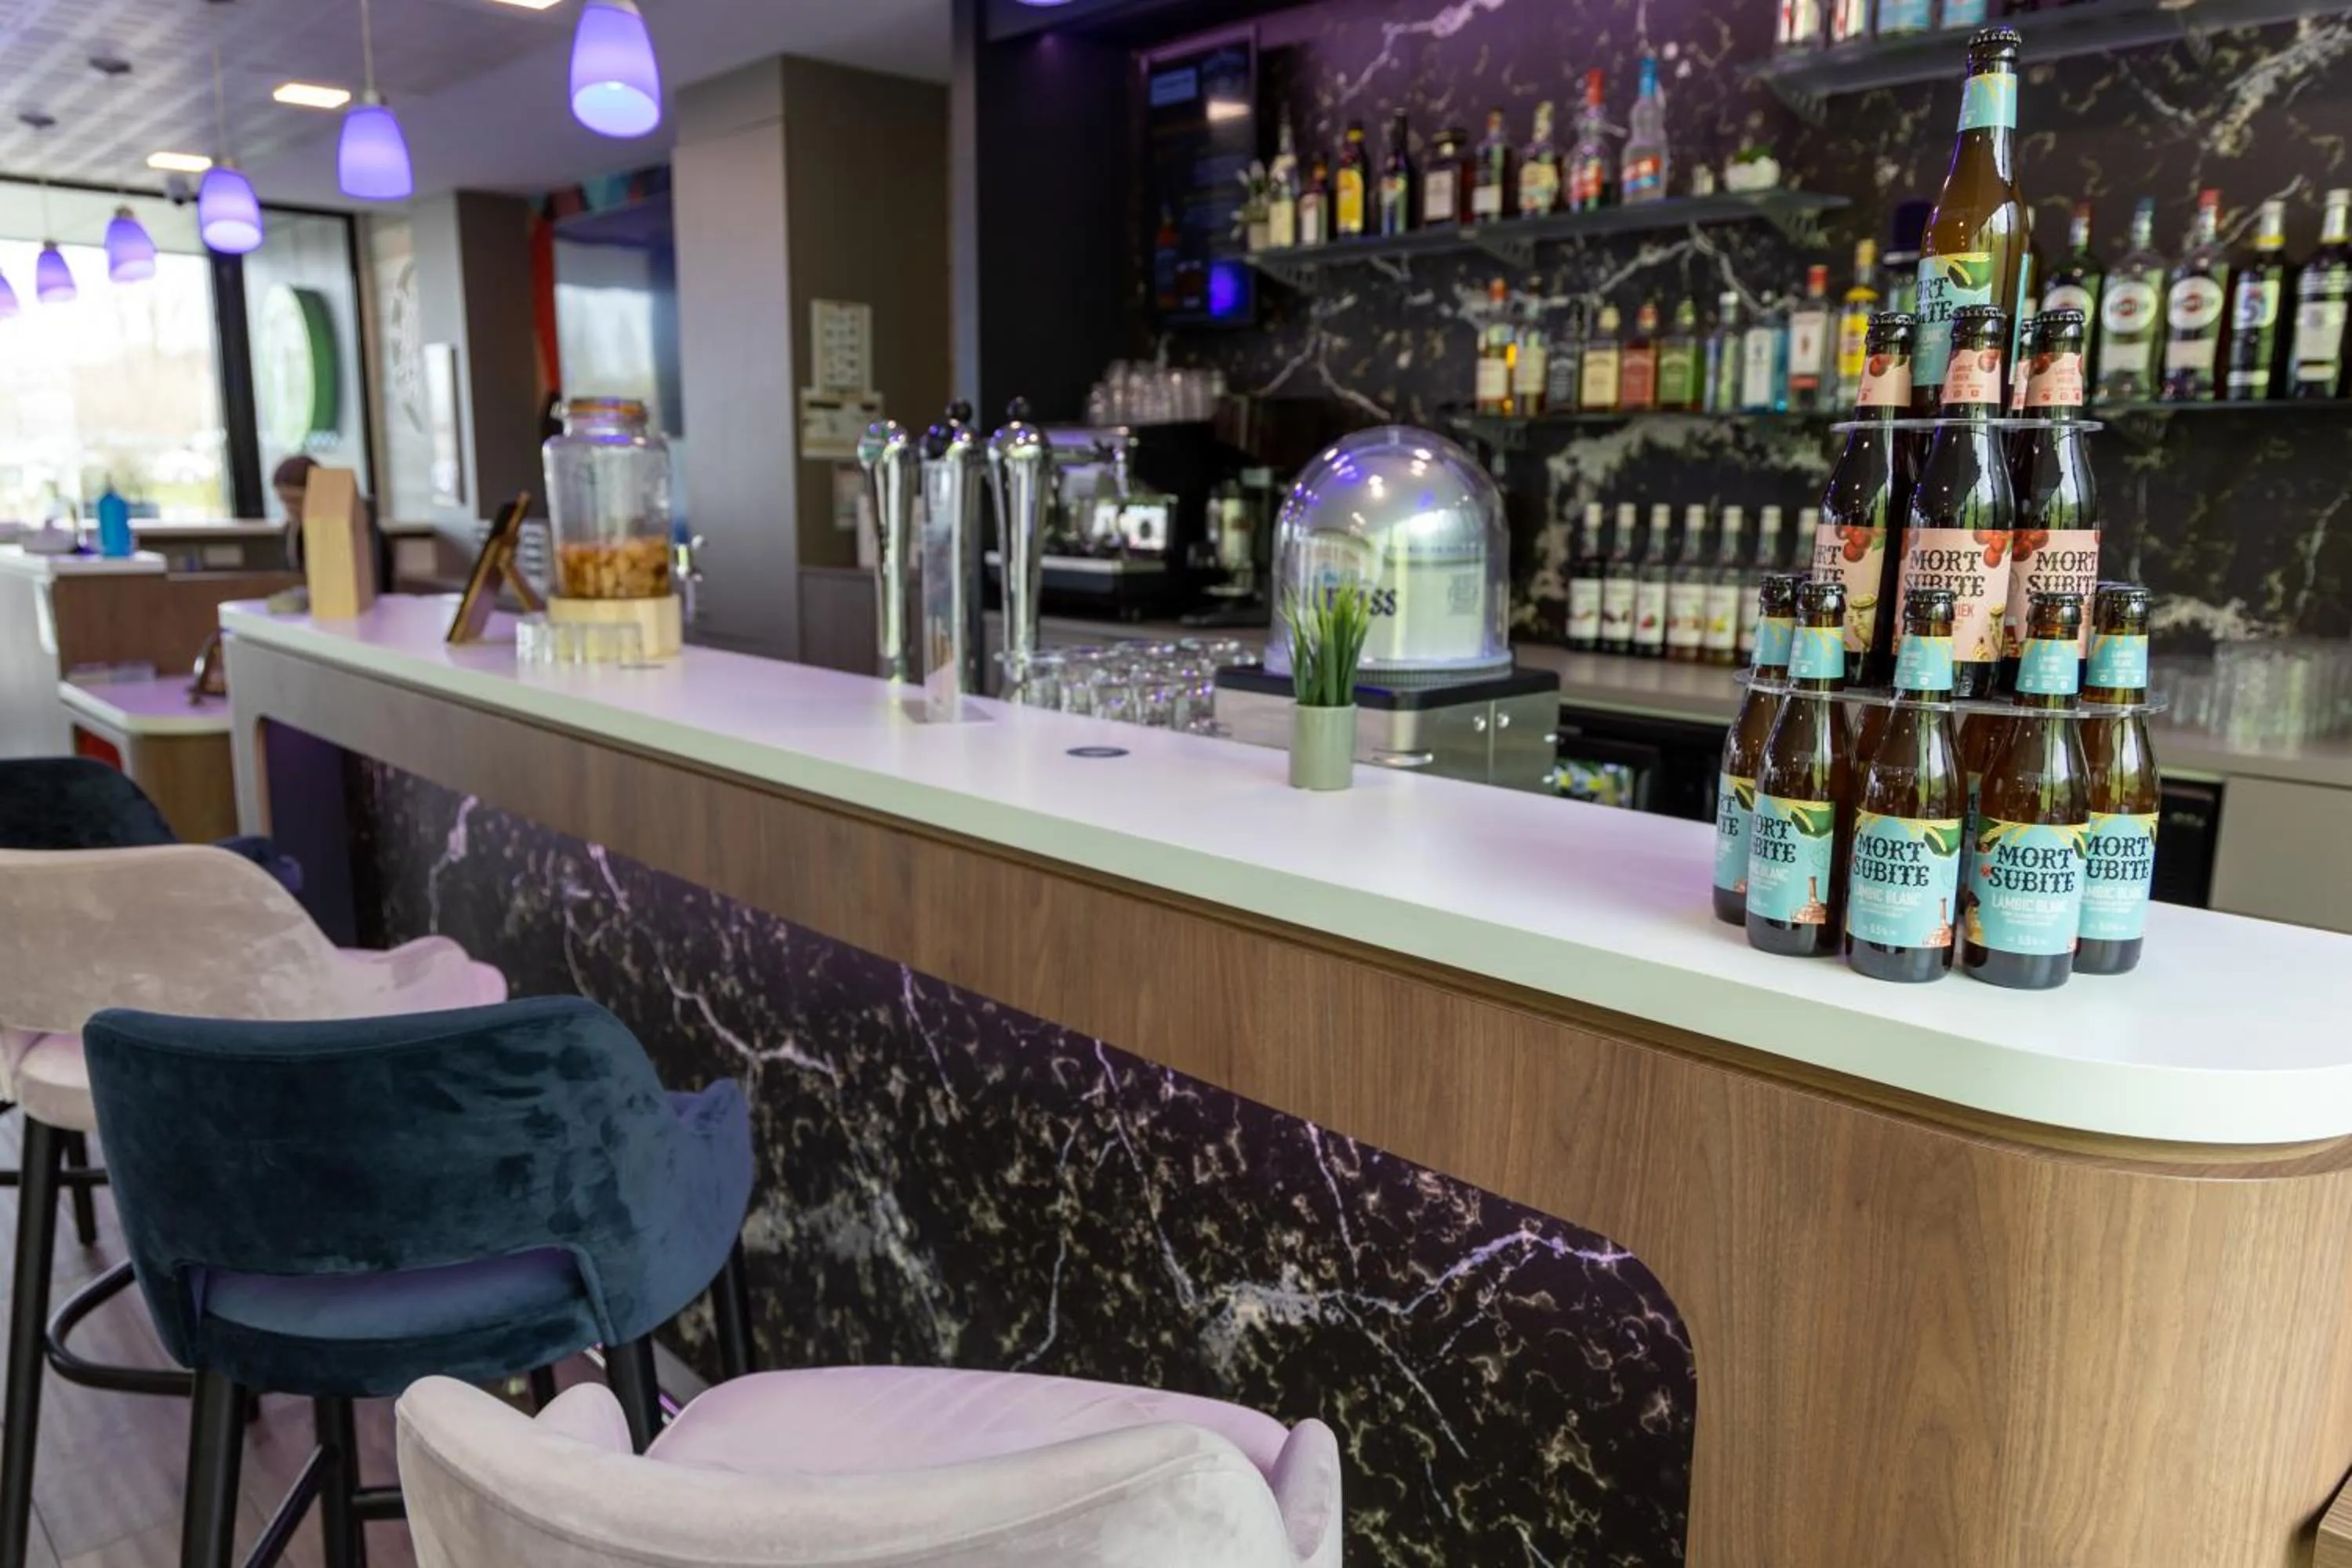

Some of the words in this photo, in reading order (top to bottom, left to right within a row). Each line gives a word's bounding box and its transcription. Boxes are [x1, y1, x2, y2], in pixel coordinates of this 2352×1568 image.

[1918, 277, 1948, 300] ORT
[1909, 550, 1981, 572] MORT
[2026, 575, 2096, 597] SUBIT
[1955, 604, 1973, 617] IEK
[1755, 815, 1791, 839] ORT
[1752, 837, 1796, 863] BITE
[1857, 833, 1926, 862] MORT
[1998, 843, 2073, 869] MORT
[1853, 855, 1929, 887] SUBITE
[1988, 866, 2074, 893] SUBITE
[2085, 858, 2149, 880] UBITE
